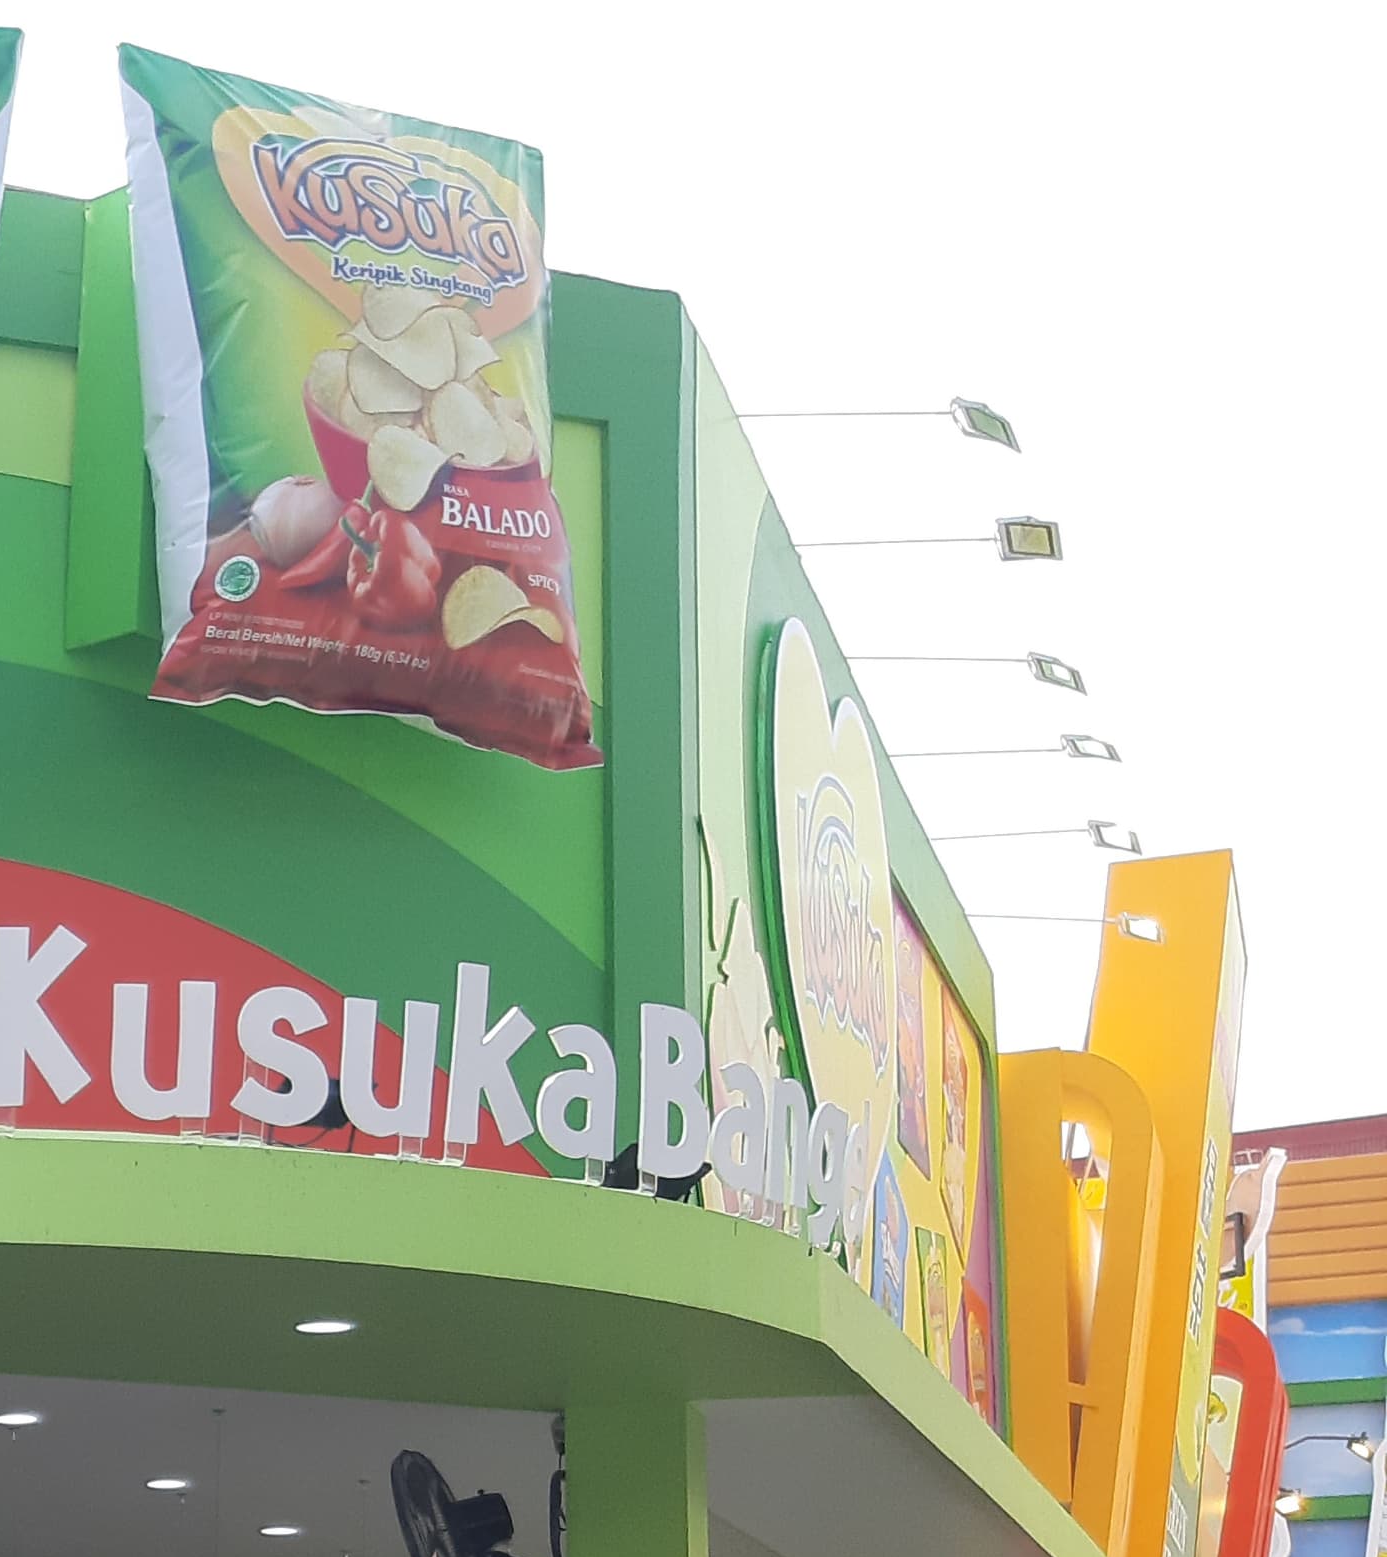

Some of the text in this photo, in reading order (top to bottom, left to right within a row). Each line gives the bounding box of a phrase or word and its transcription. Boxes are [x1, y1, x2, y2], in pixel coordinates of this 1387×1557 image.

[332, 255, 493, 308] Keripik Singkong
[443, 483, 469, 498] RASA
[441, 496, 551, 539] BALADO
[528, 574, 560, 596] SPICY
[205, 626, 240, 641] Berat
